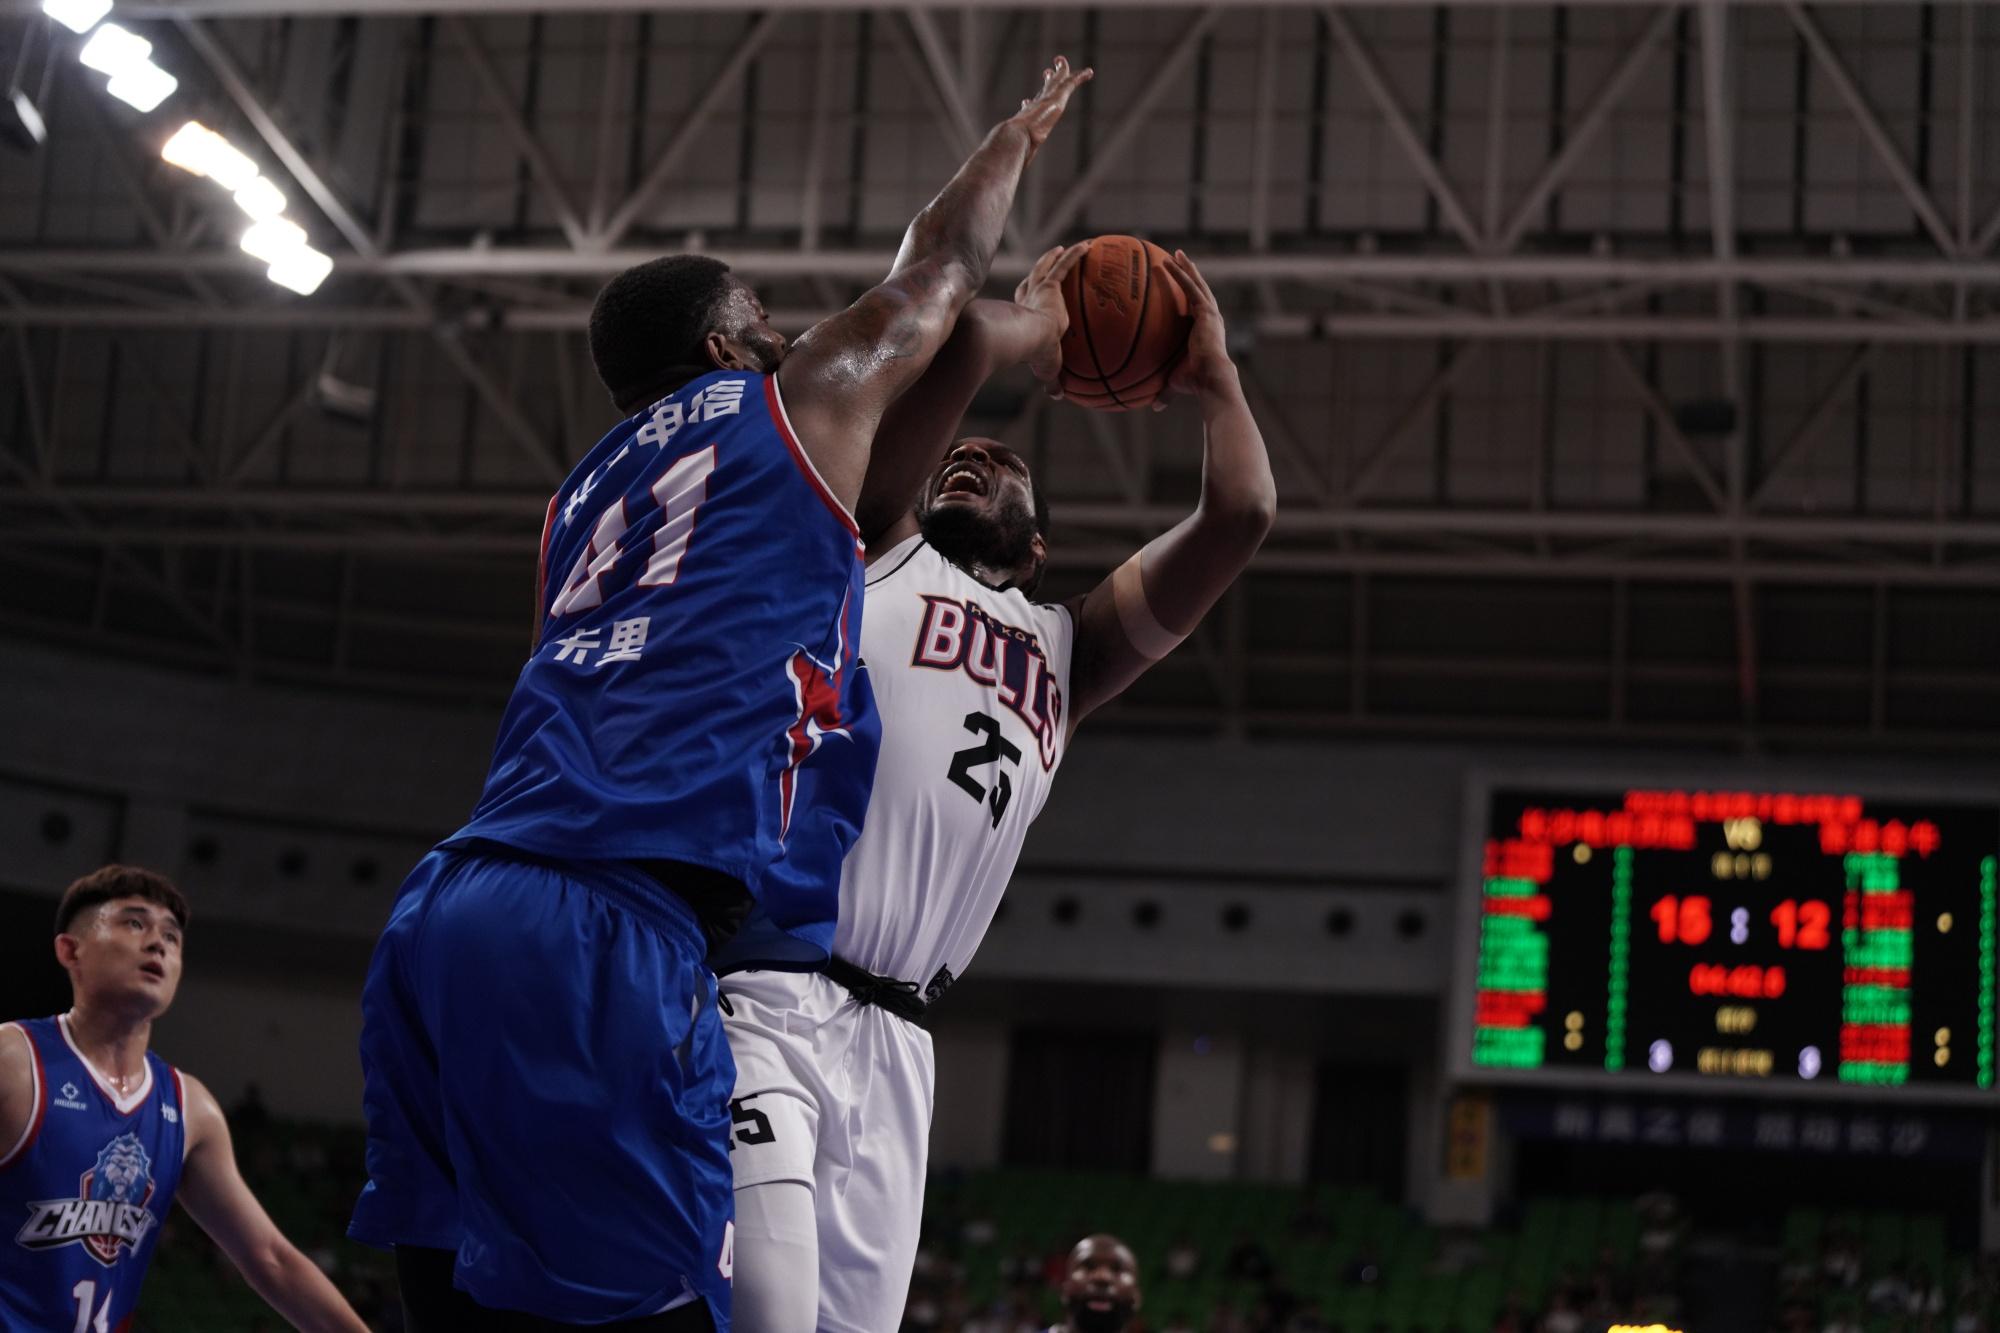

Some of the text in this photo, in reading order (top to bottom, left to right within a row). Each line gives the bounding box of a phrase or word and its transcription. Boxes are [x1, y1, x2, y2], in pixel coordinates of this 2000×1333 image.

[550, 443, 718, 618] 41
[911, 593, 1062, 772] BULLS
[946, 711, 1022, 830] 25
[1770, 899, 1831, 950] 12
[729, 1094, 776, 1151] 5
